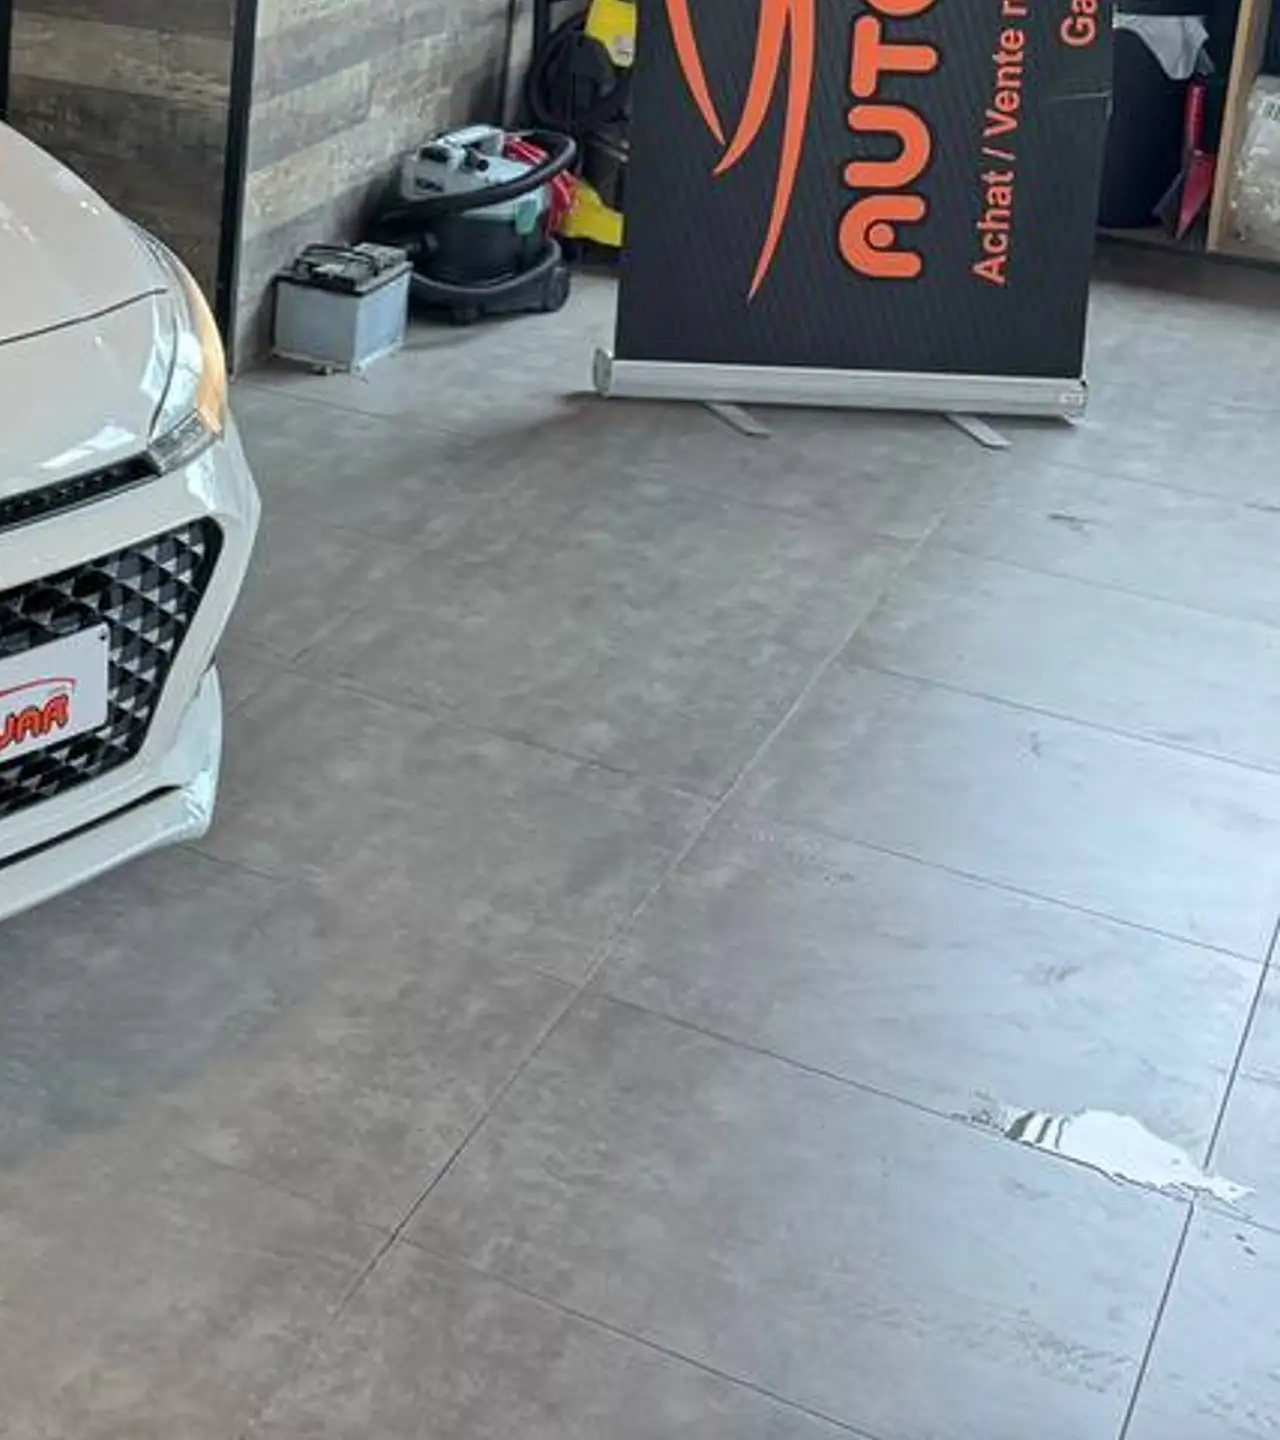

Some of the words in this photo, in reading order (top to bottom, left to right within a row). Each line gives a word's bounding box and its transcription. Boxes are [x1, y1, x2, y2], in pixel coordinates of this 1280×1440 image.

[983, 27, 1026, 138] Vente
[982, 145, 1017, 161] /
[972, 170, 1016, 285] Achat
